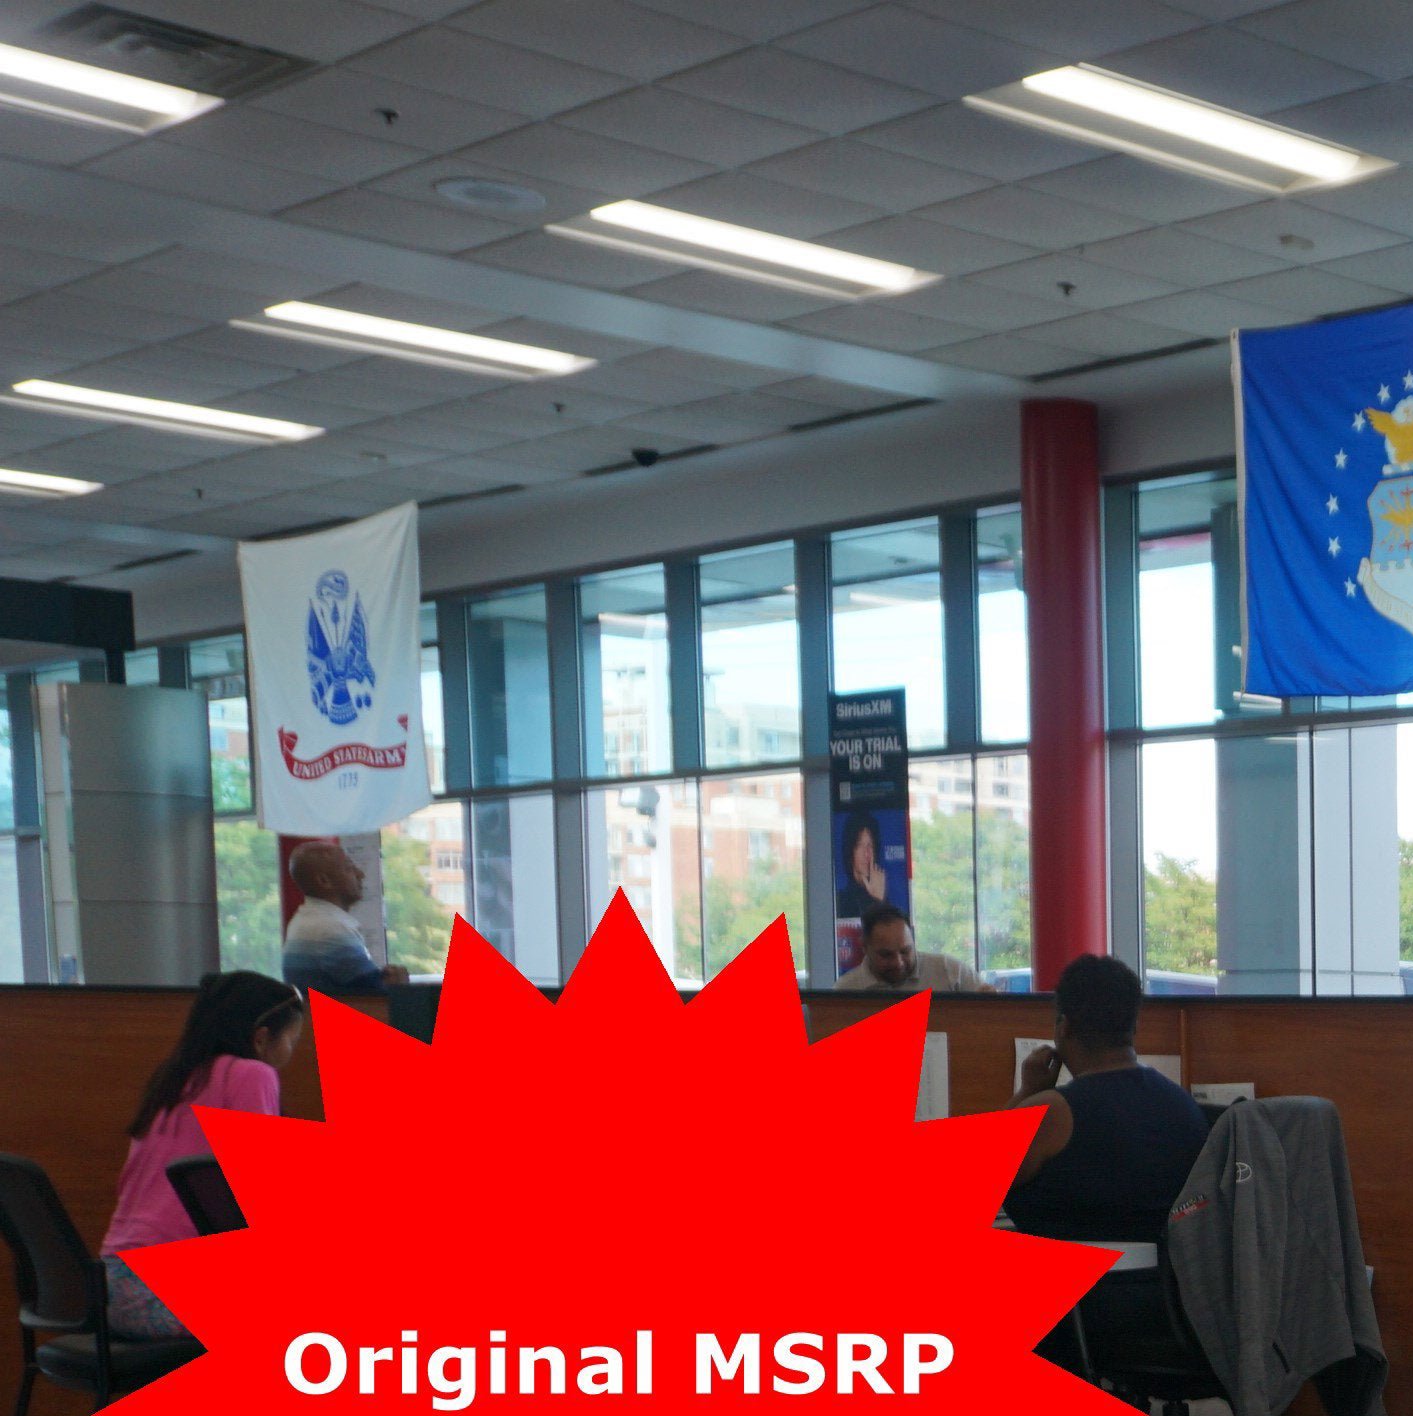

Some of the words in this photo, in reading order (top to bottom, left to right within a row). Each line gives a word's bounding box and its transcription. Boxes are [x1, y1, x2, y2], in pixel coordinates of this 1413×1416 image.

[836, 698, 892, 718] SiriusXM
[830, 738, 863, 756] YOUR
[866, 735, 902, 754] TRIAL
[292, 756, 332, 778] UNITED
[333, 746, 368, 764] STATES
[368, 748, 406, 765] ARM
[848, 753, 861, 771] IS
[863, 753, 882, 770] ON
